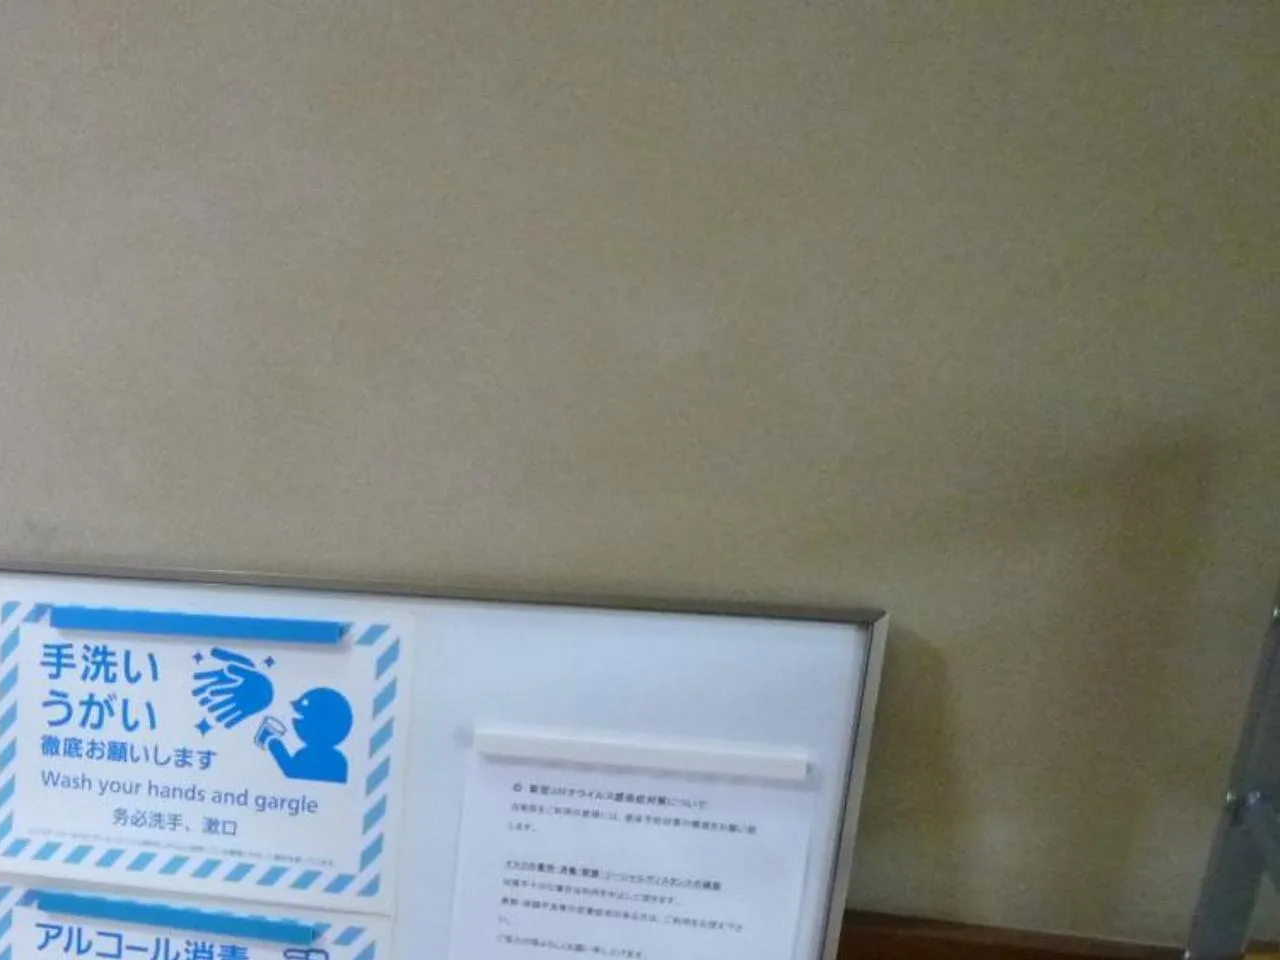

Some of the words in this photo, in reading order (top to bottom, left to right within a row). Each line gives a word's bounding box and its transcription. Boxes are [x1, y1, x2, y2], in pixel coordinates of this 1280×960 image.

[40, 643, 159, 684] 手洗い
[40, 689, 157, 732] うがい
[40, 735, 217, 770] 徹底お願いします
[41, 769, 92, 791] Wash
[98, 780, 141, 797] your
[147, 780, 206, 802] hands
[211, 789, 249, 807] and
[255, 794, 319, 816] gargle
